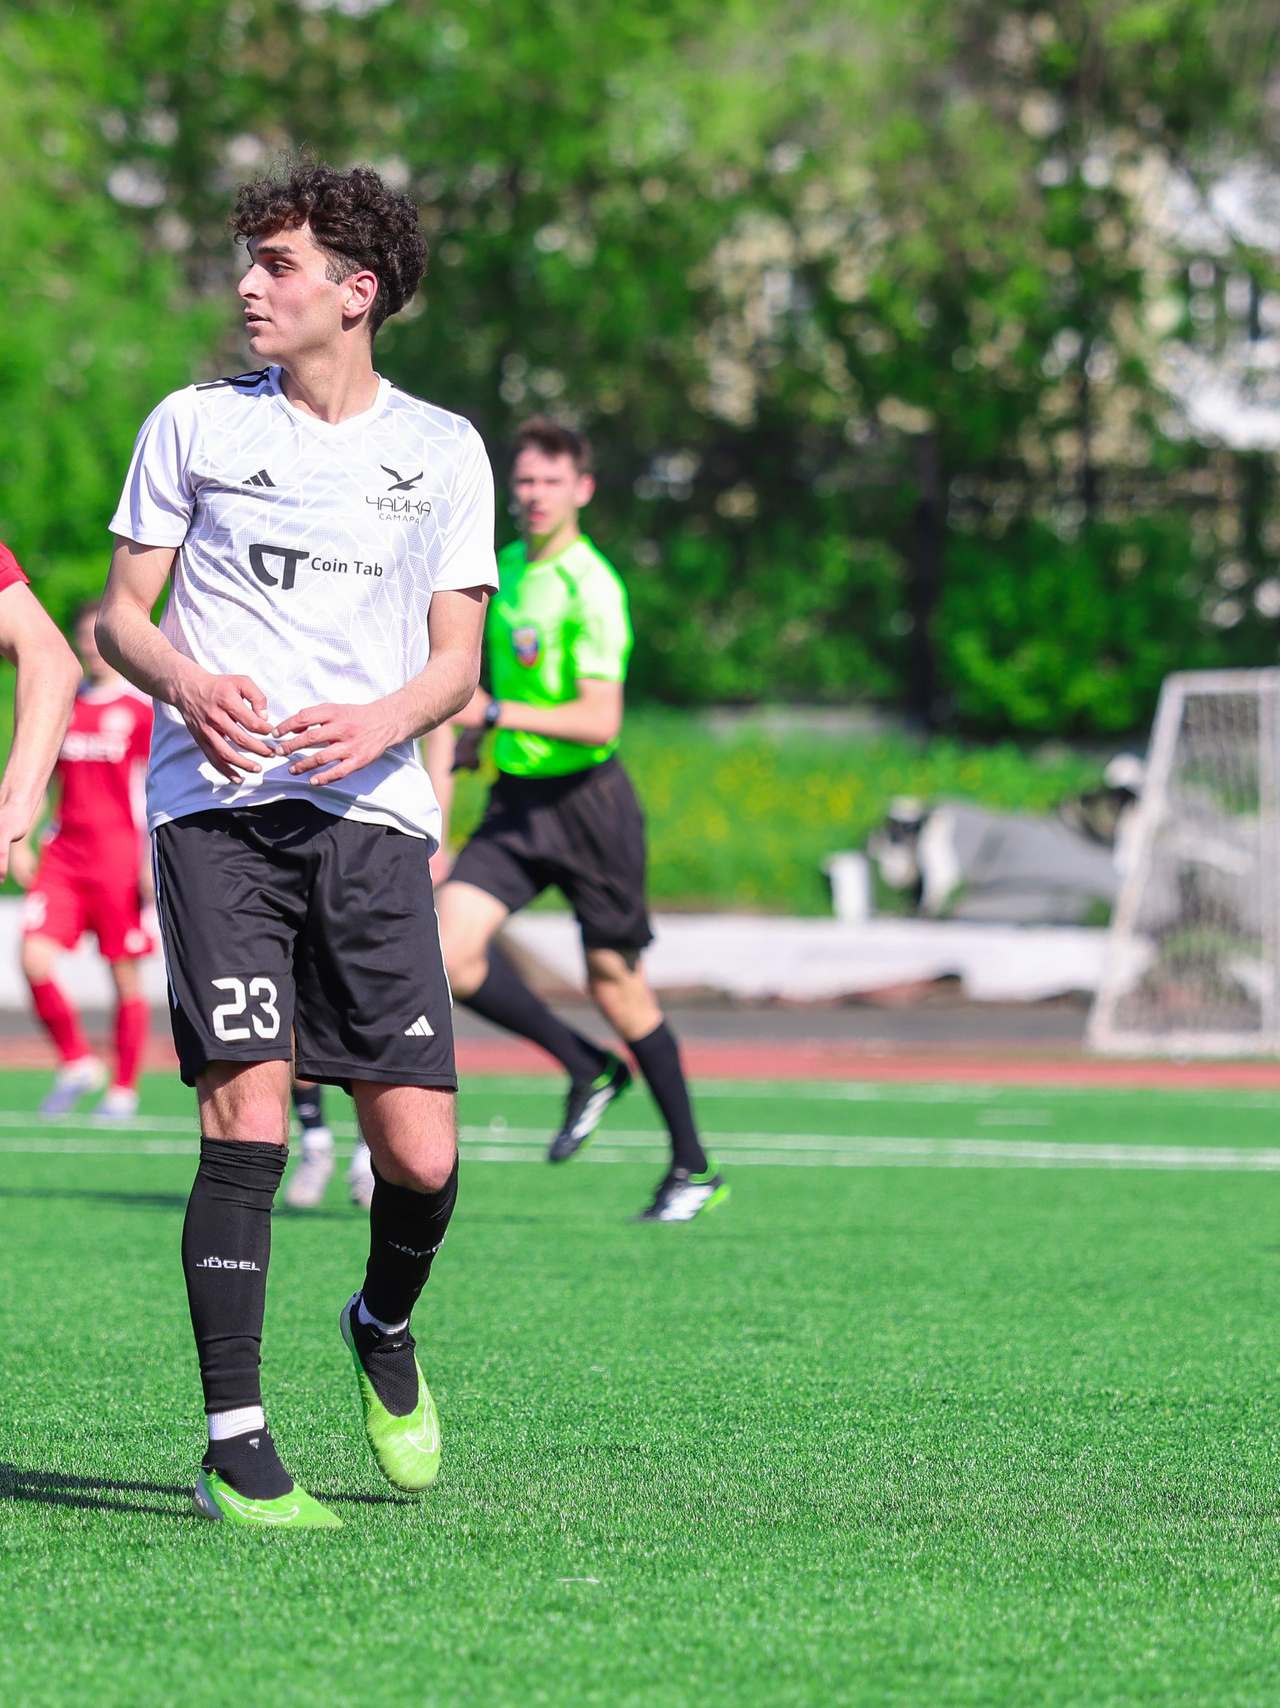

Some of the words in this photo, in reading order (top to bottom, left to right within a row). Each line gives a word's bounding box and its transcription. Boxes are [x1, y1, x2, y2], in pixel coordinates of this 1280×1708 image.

[365, 495, 431, 517] ЧАЙКА
[378, 512, 420, 525] САМАРА
[311, 557, 348, 573] Coin
[353, 560, 383, 577] Tab
[211, 977, 281, 1041] 23
[195, 1256, 261, 1271] JÖGEL
